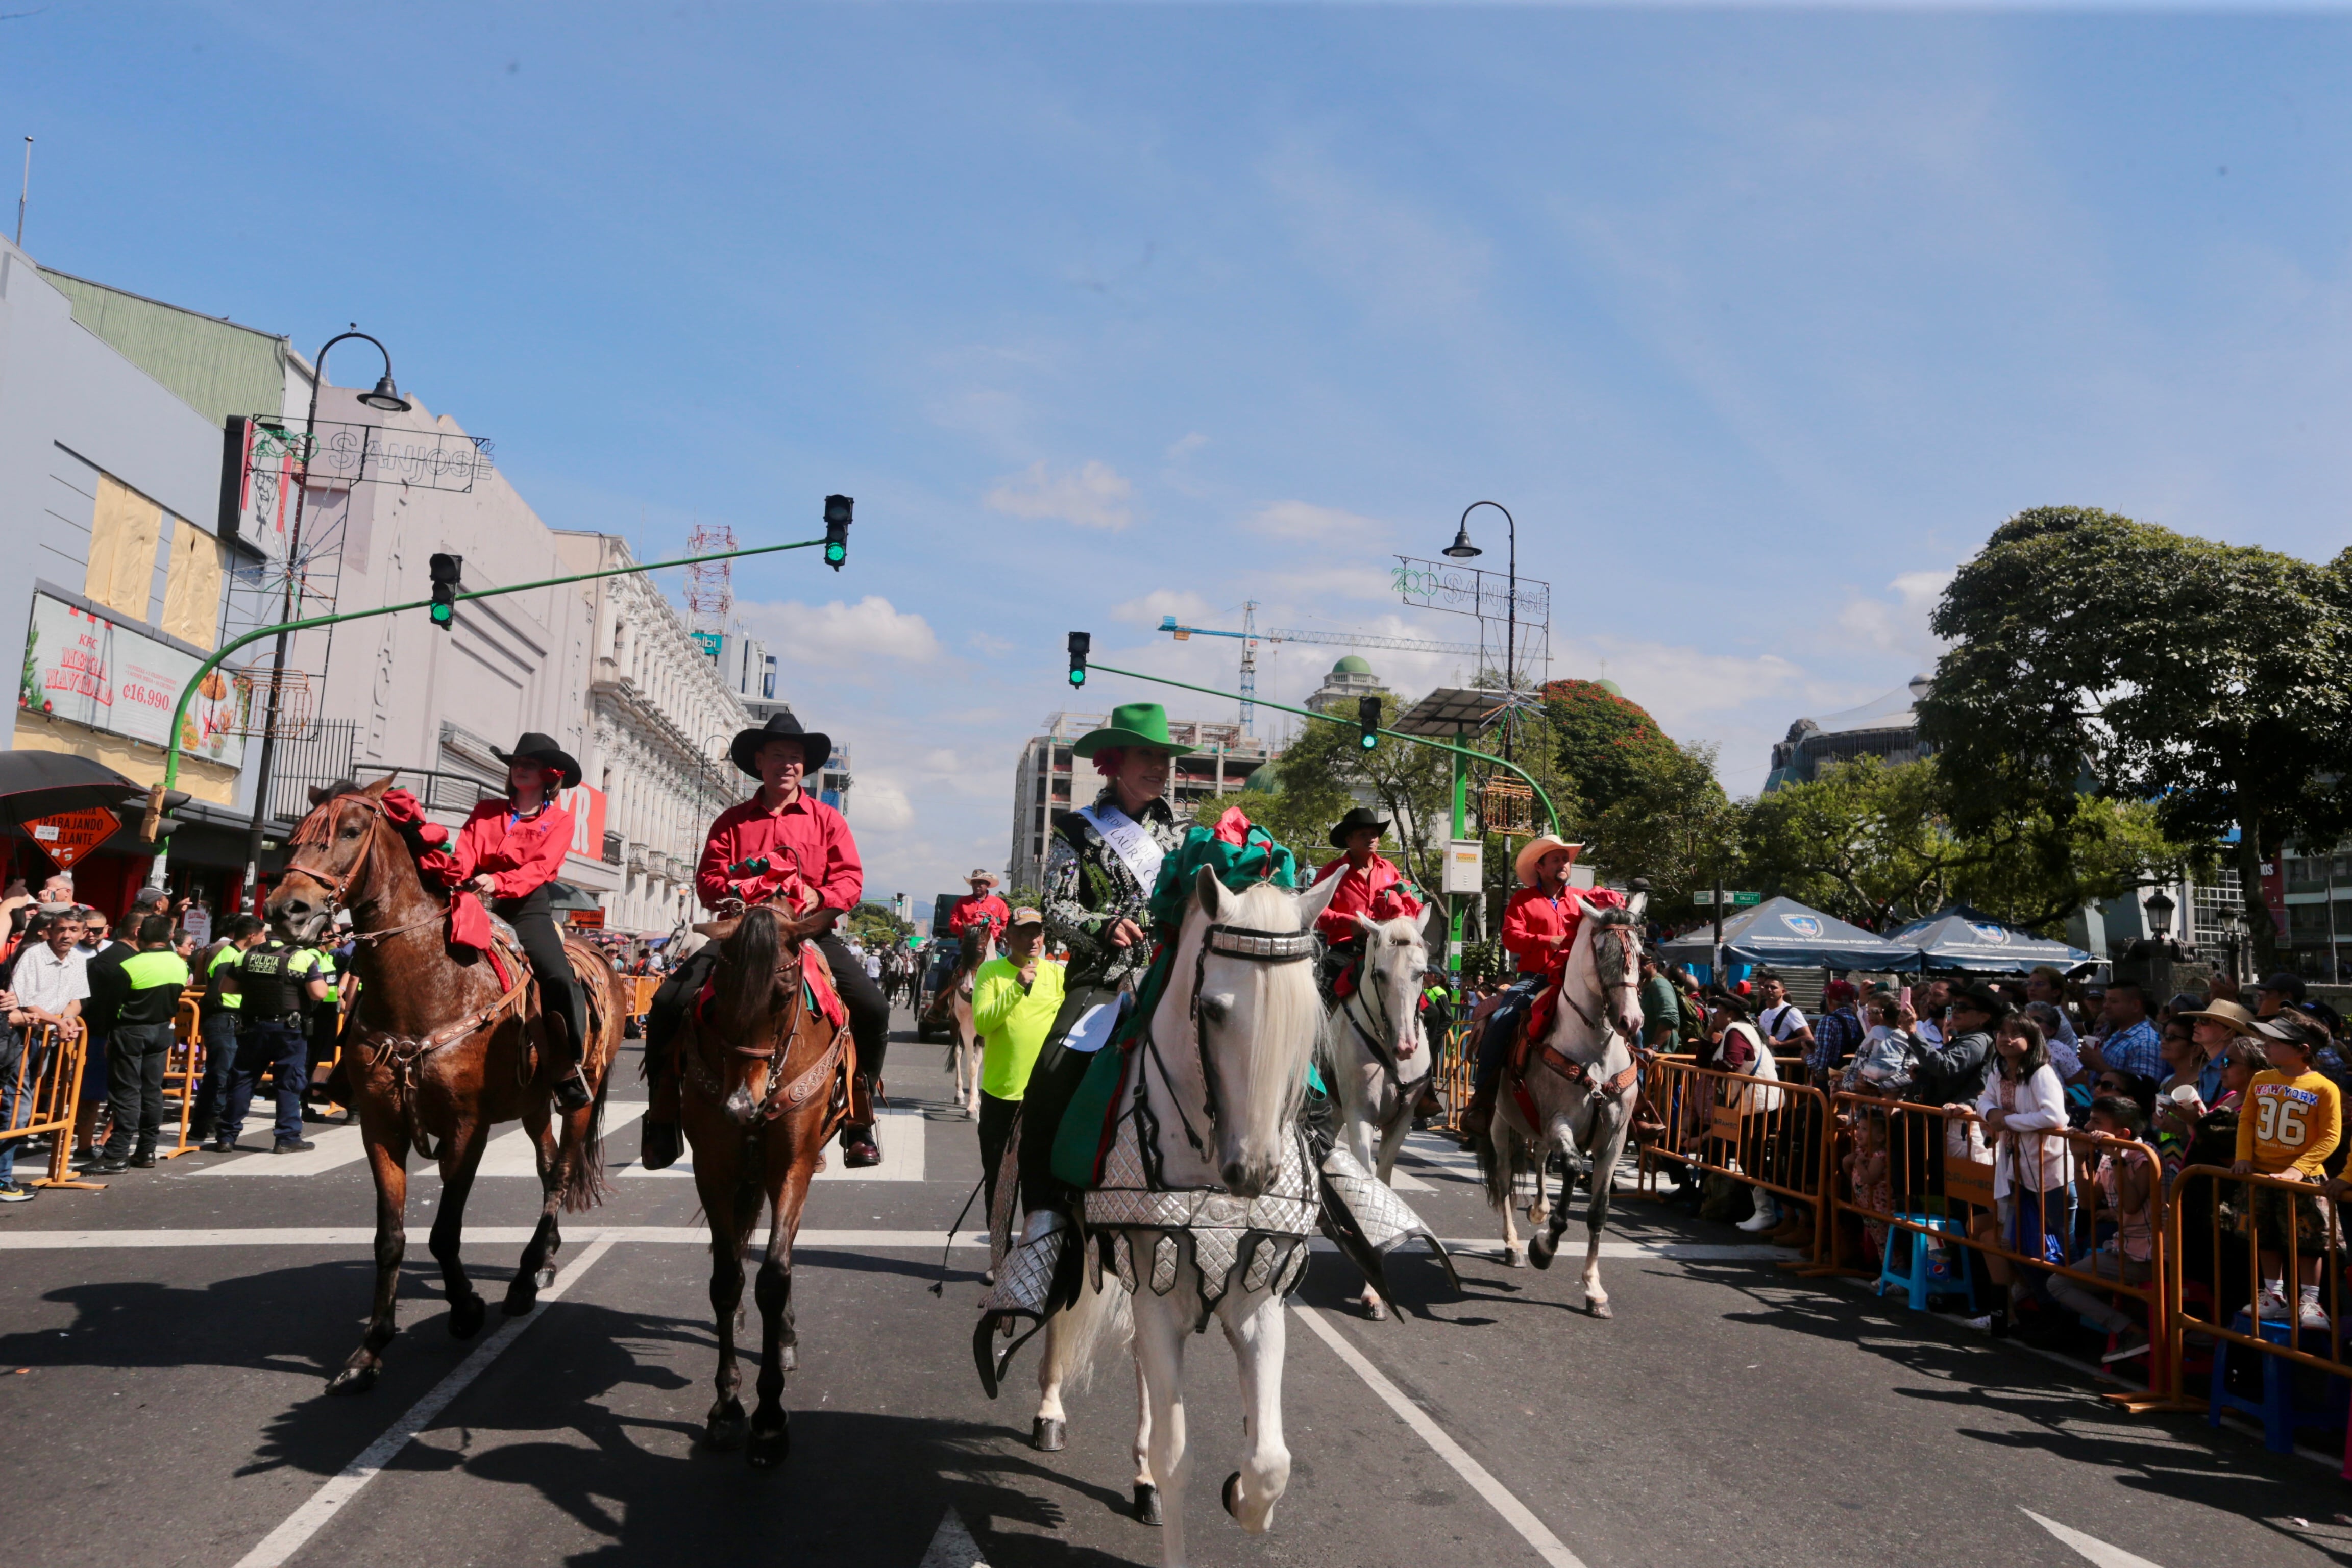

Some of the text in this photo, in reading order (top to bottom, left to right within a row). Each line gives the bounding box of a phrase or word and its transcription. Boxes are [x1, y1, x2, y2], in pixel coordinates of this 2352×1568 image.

[78, 633, 98, 650] KFC
[61, 647, 107, 682] MEGA
[45, 668, 114, 707] NAVIDAD
[38, 817, 104, 831] TRABAJANDO
[1102, 812, 1140, 844] DEDICADA
[43, 832, 94, 845] ELANTE
[1110, 829, 1144, 868] LAURA
[249, 954, 279, 966] POLICIA
[2255, 1084, 2319, 1107] NEW YORK
